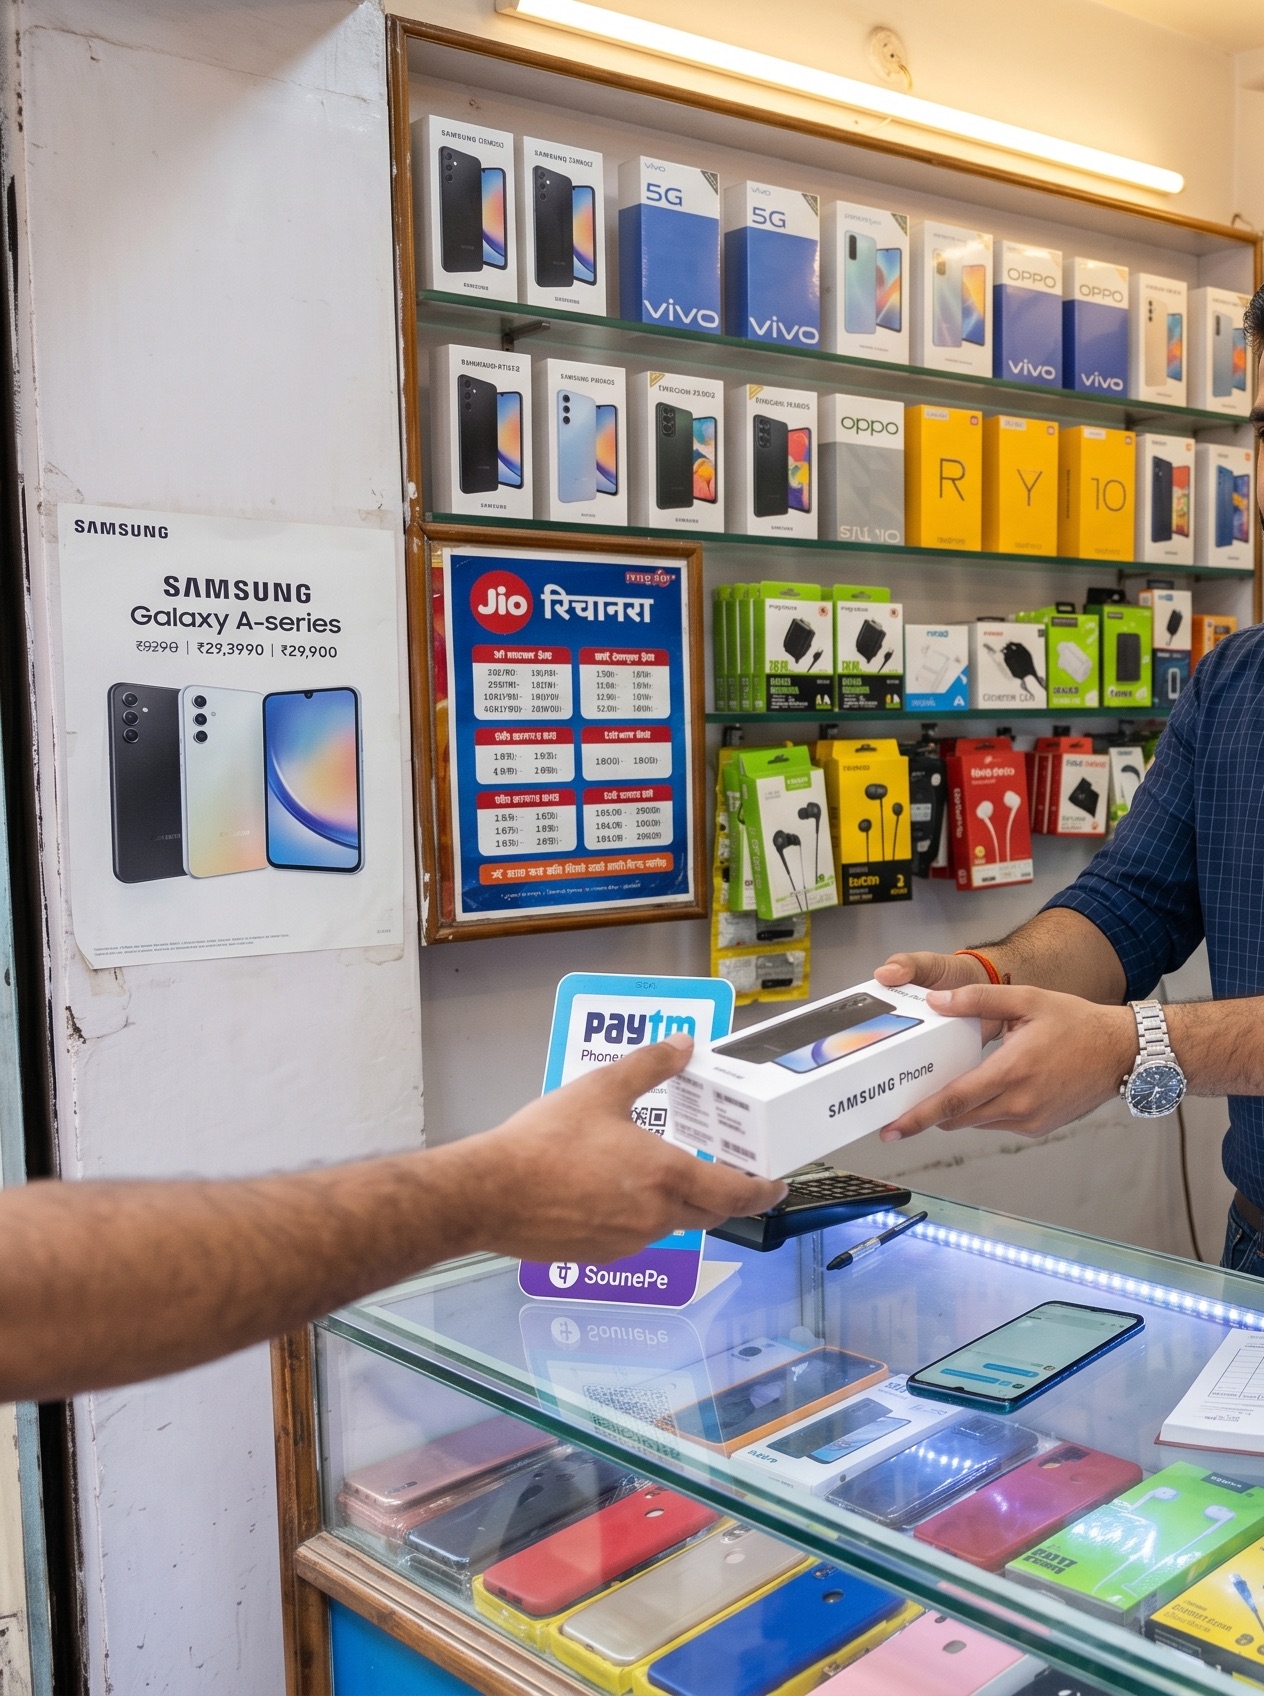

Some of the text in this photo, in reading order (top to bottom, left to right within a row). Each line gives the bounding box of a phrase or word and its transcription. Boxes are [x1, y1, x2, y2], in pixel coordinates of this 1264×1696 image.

[646, 182, 683, 207] 5G
[752, 206, 786, 229] 5G
[1007, 267, 1057, 289] OPPO
[1079, 284, 1124, 303] OPPO
[643, 298, 720, 328] vivo
[750, 316, 819, 344] vivo
[1008, 358, 1056, 380] vivo
[1081, 371, 1124, 391] vivo
[841, 416, 899, 437] oppo
[939, 457, 966, 502] R
[1016, 468, 1043, 507] Y
[1090, 477, 1127, 512] 10
[74, 519, 169, 540] SAMSUNG
[163, 575, 312, 604] SAMSUNG
[478, 585, 528, 616] Jio
[540, 583, 654, 623] रिचानरा
[130, 605, 342, 636] Galaxy A-series
[197, 642, 264, 657] ₹29,3990
[280, 644, 338, 659] ₹29,900
[583, 1009, 696, 1045] paytm
[828, 1062, 934, 1118] SAMSUNG Phone
[584, 1265, 668, 1289] SounePe
